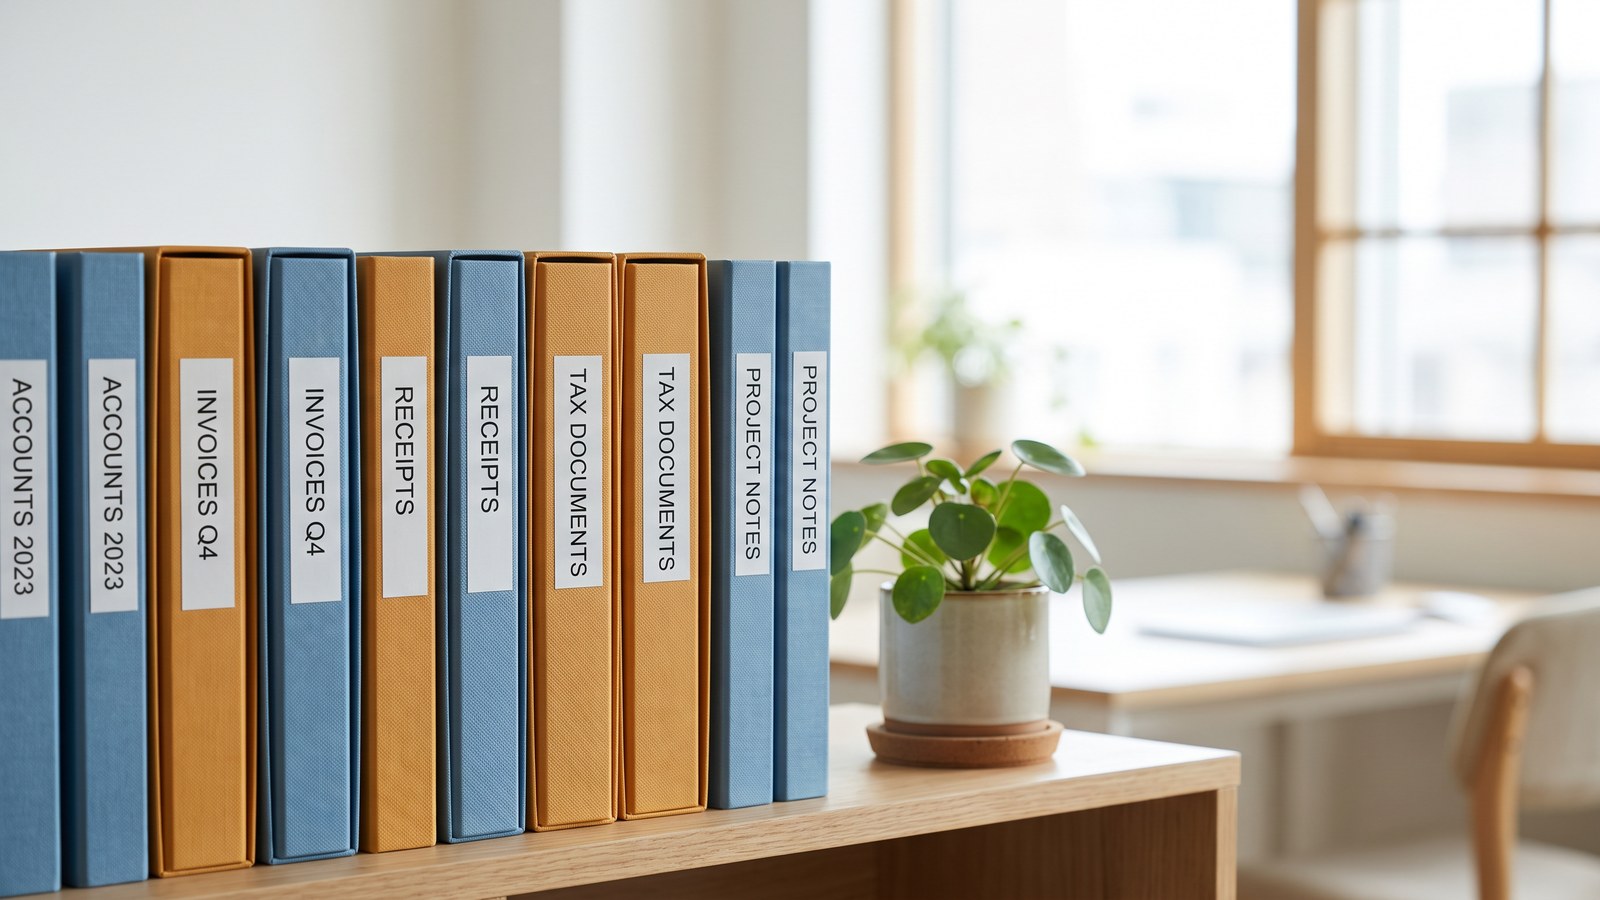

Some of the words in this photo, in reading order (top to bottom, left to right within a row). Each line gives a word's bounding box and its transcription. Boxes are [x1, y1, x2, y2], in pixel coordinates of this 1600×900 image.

[569, 367, 587, 415] TAX
[658, 366, 675, 413] TAX
[745, 368, 761, 475] PROJECT
[802, 365, 818, 471] PROJECT
[12, 377, 34, 527] ACCOUNTS
[102, 376, 124, 523] ACCOUNTS
[196, 389, 218, 516] INVOICES
[305, 388, 326, 513] INVOICES
[394, 386, 415, 516] RECEIPTS
[480, 386, 499, 513] RECEIPTS
[569, 423, 588, 577] DOCUMENTS
[658, 420, 675, 571] DOCUMENTS
[13, 535, 34, 596] 2023
[103, 531, 124, 591] 2023
[197, 524, 219, 561] Q4
[304, 521, 326, 557] Q4
[745, 481, 761, 560] NOTES
[802, 478, 817, 555] NOTES
